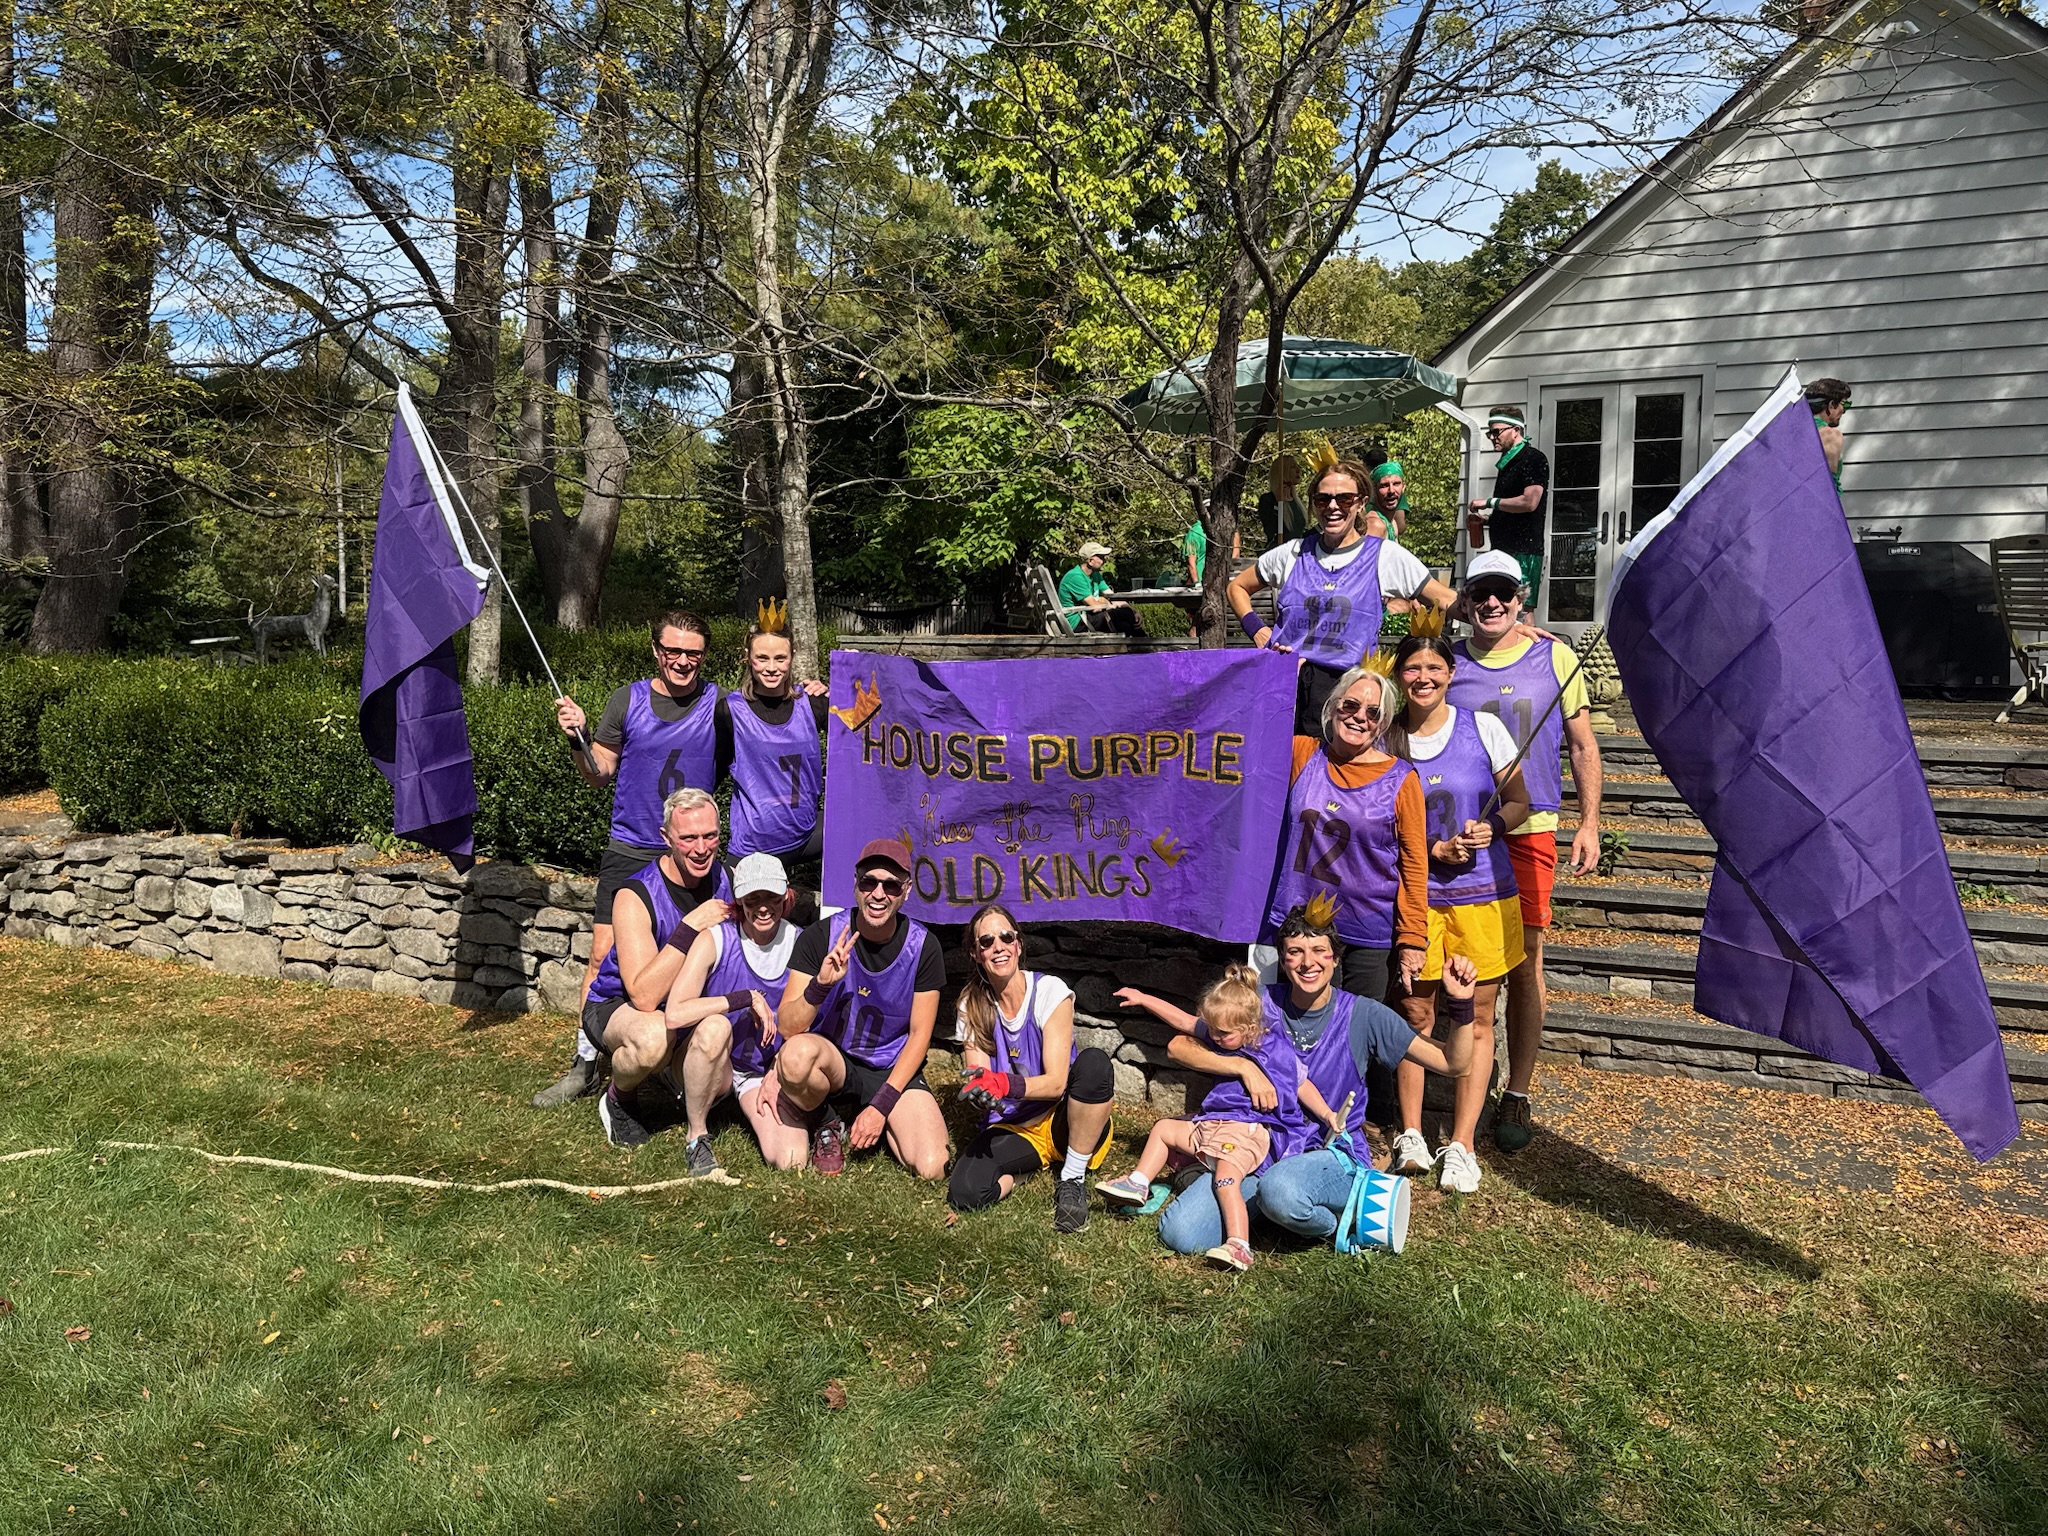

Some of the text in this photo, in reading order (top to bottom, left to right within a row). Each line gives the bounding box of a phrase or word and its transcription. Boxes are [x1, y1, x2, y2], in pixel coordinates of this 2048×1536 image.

[1302, 595, 1352, 654] 12
[657, 748, 685, 801] 6
[862, 721, 1244, 785] HOUSE PURPLE
[920, 791, 977, 847] Kiss
[1069, 792, 1142, 850] Ring
[1293, 808, 1350, 887] 12
[913, 850, 1152, 907] OLD KINGS
